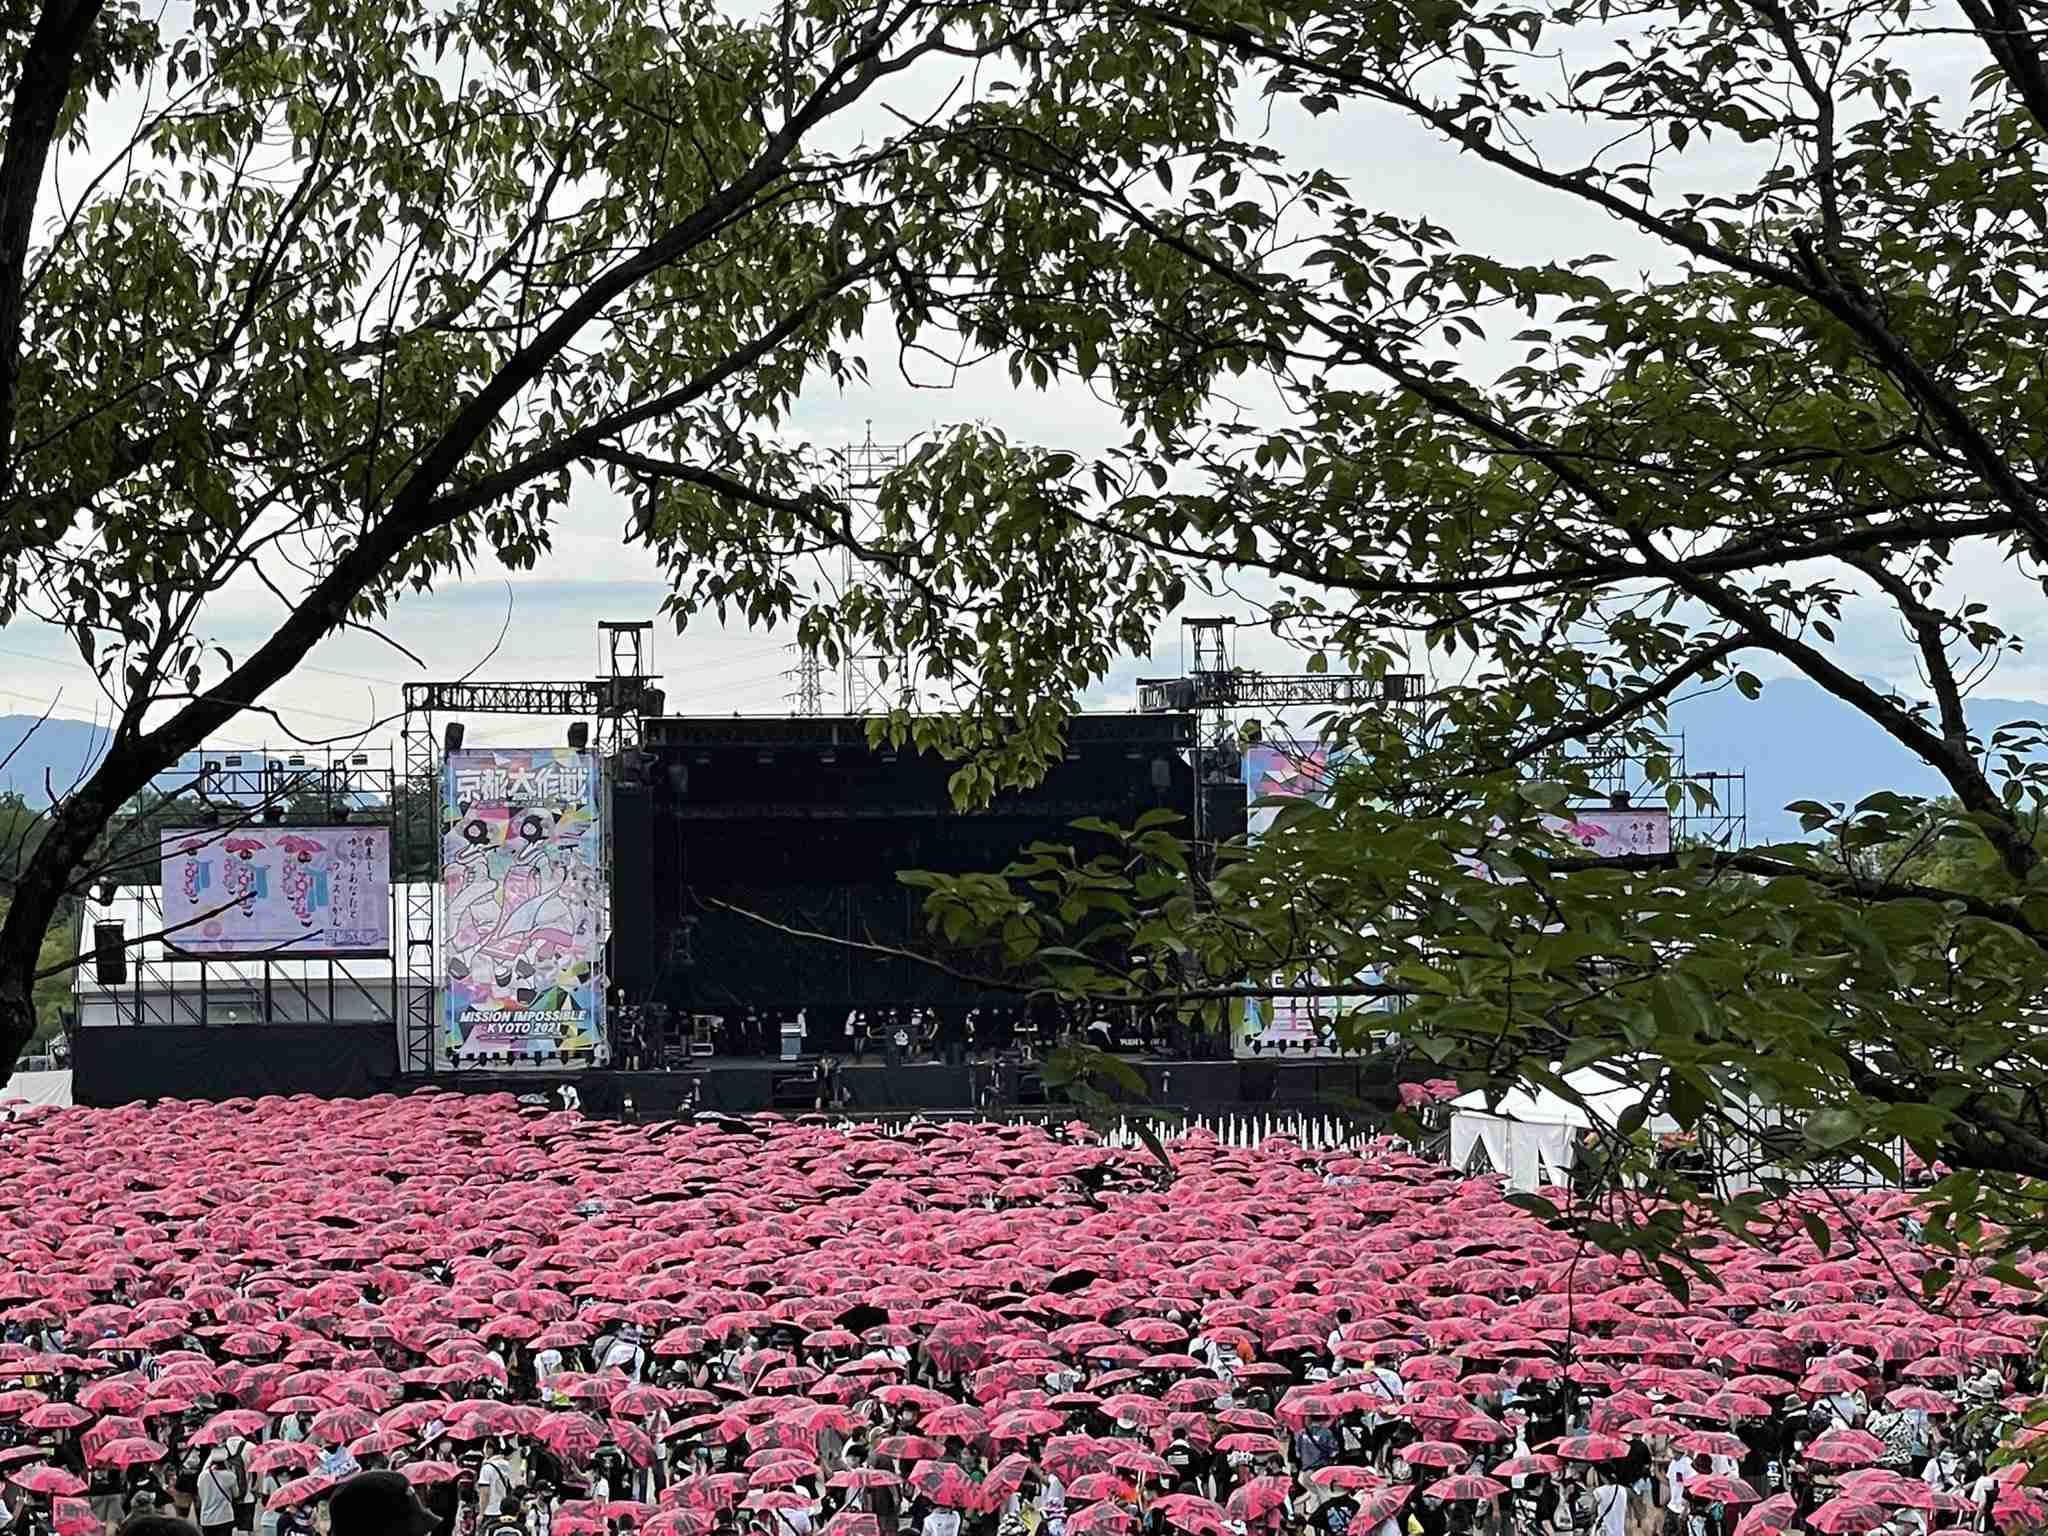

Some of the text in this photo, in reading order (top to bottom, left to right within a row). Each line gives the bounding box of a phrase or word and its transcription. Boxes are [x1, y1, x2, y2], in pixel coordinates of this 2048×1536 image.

[455, 768, 588, 803] 京都大作戦
[460, 1009, 586, 1022] MISSION IMPOSSIBLE
[487, 1022, 561, 1034] KYOTO 2021
